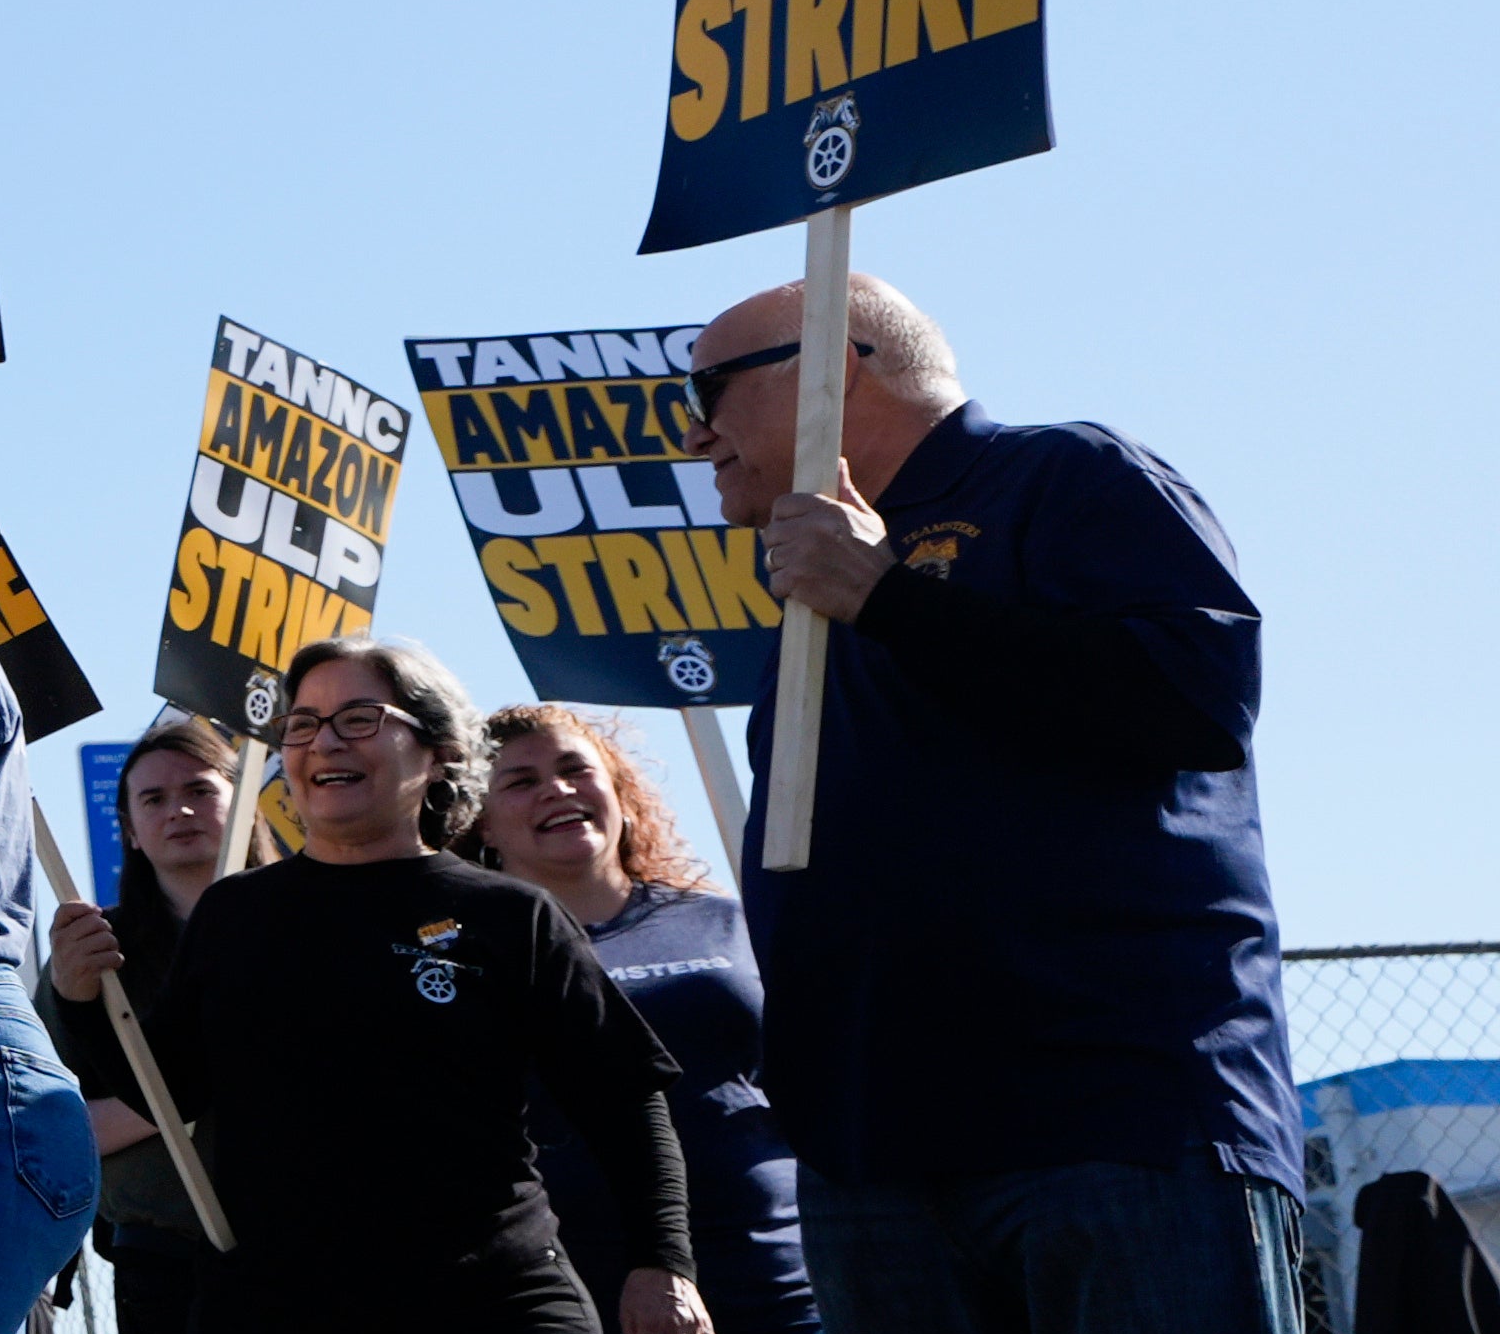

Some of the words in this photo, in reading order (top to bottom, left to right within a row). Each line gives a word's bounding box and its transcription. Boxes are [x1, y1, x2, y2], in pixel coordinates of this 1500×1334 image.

[222, 322, 404, 454] TANNC
[448, 382, 688, 465] AMAZO
[189, 455, 381, 591] ULP
[209, 381, 394, 536] AMAZON
[480, 527, 784, 638] STRIK
